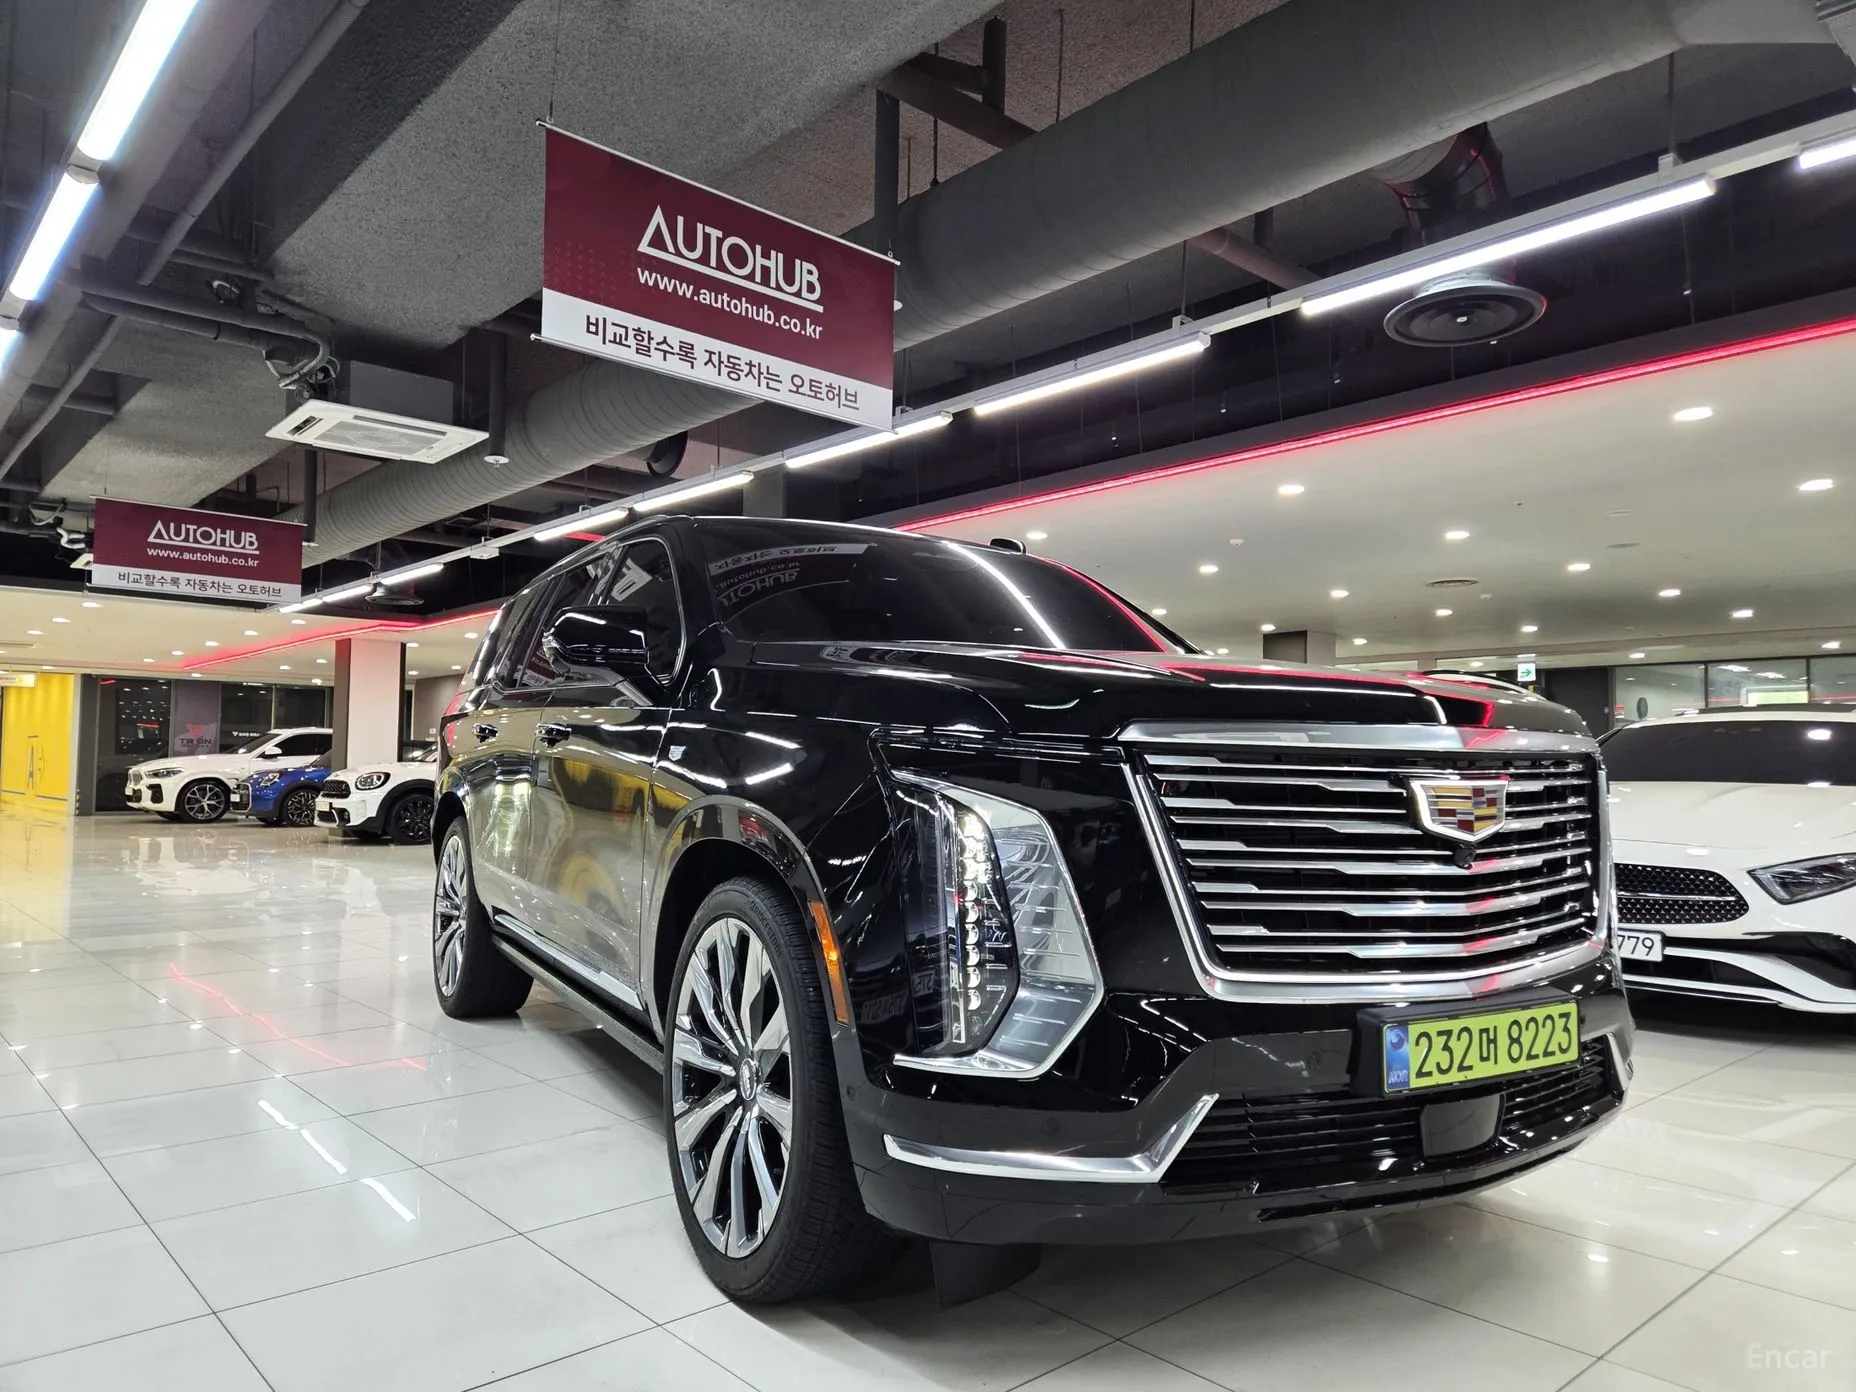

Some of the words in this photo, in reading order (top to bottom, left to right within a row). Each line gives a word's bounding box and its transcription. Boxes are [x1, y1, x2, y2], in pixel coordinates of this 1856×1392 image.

[637, 205, 823, 312] AUTOHUB
[637, 267, 823, 340] www.autohub.co.kr
[585, 315, 697, 370] 비교할수록
[703, 348, 783, 392] 자동차는
[788, 374, 860, 411] 오토허브
[147, 520, 260, 554] AUTOHUB
[147, 548, 259, 567] www.autohub.co.kr
[118, 571, 181, 589] 비교할수록
[184, 579, 234, 594] 자동차는
[236, 584, 283, 598] 오토허브
[1415, 1025, 1498, 1079] 232머
[1507, 1012, 1572, 1063] 8223
